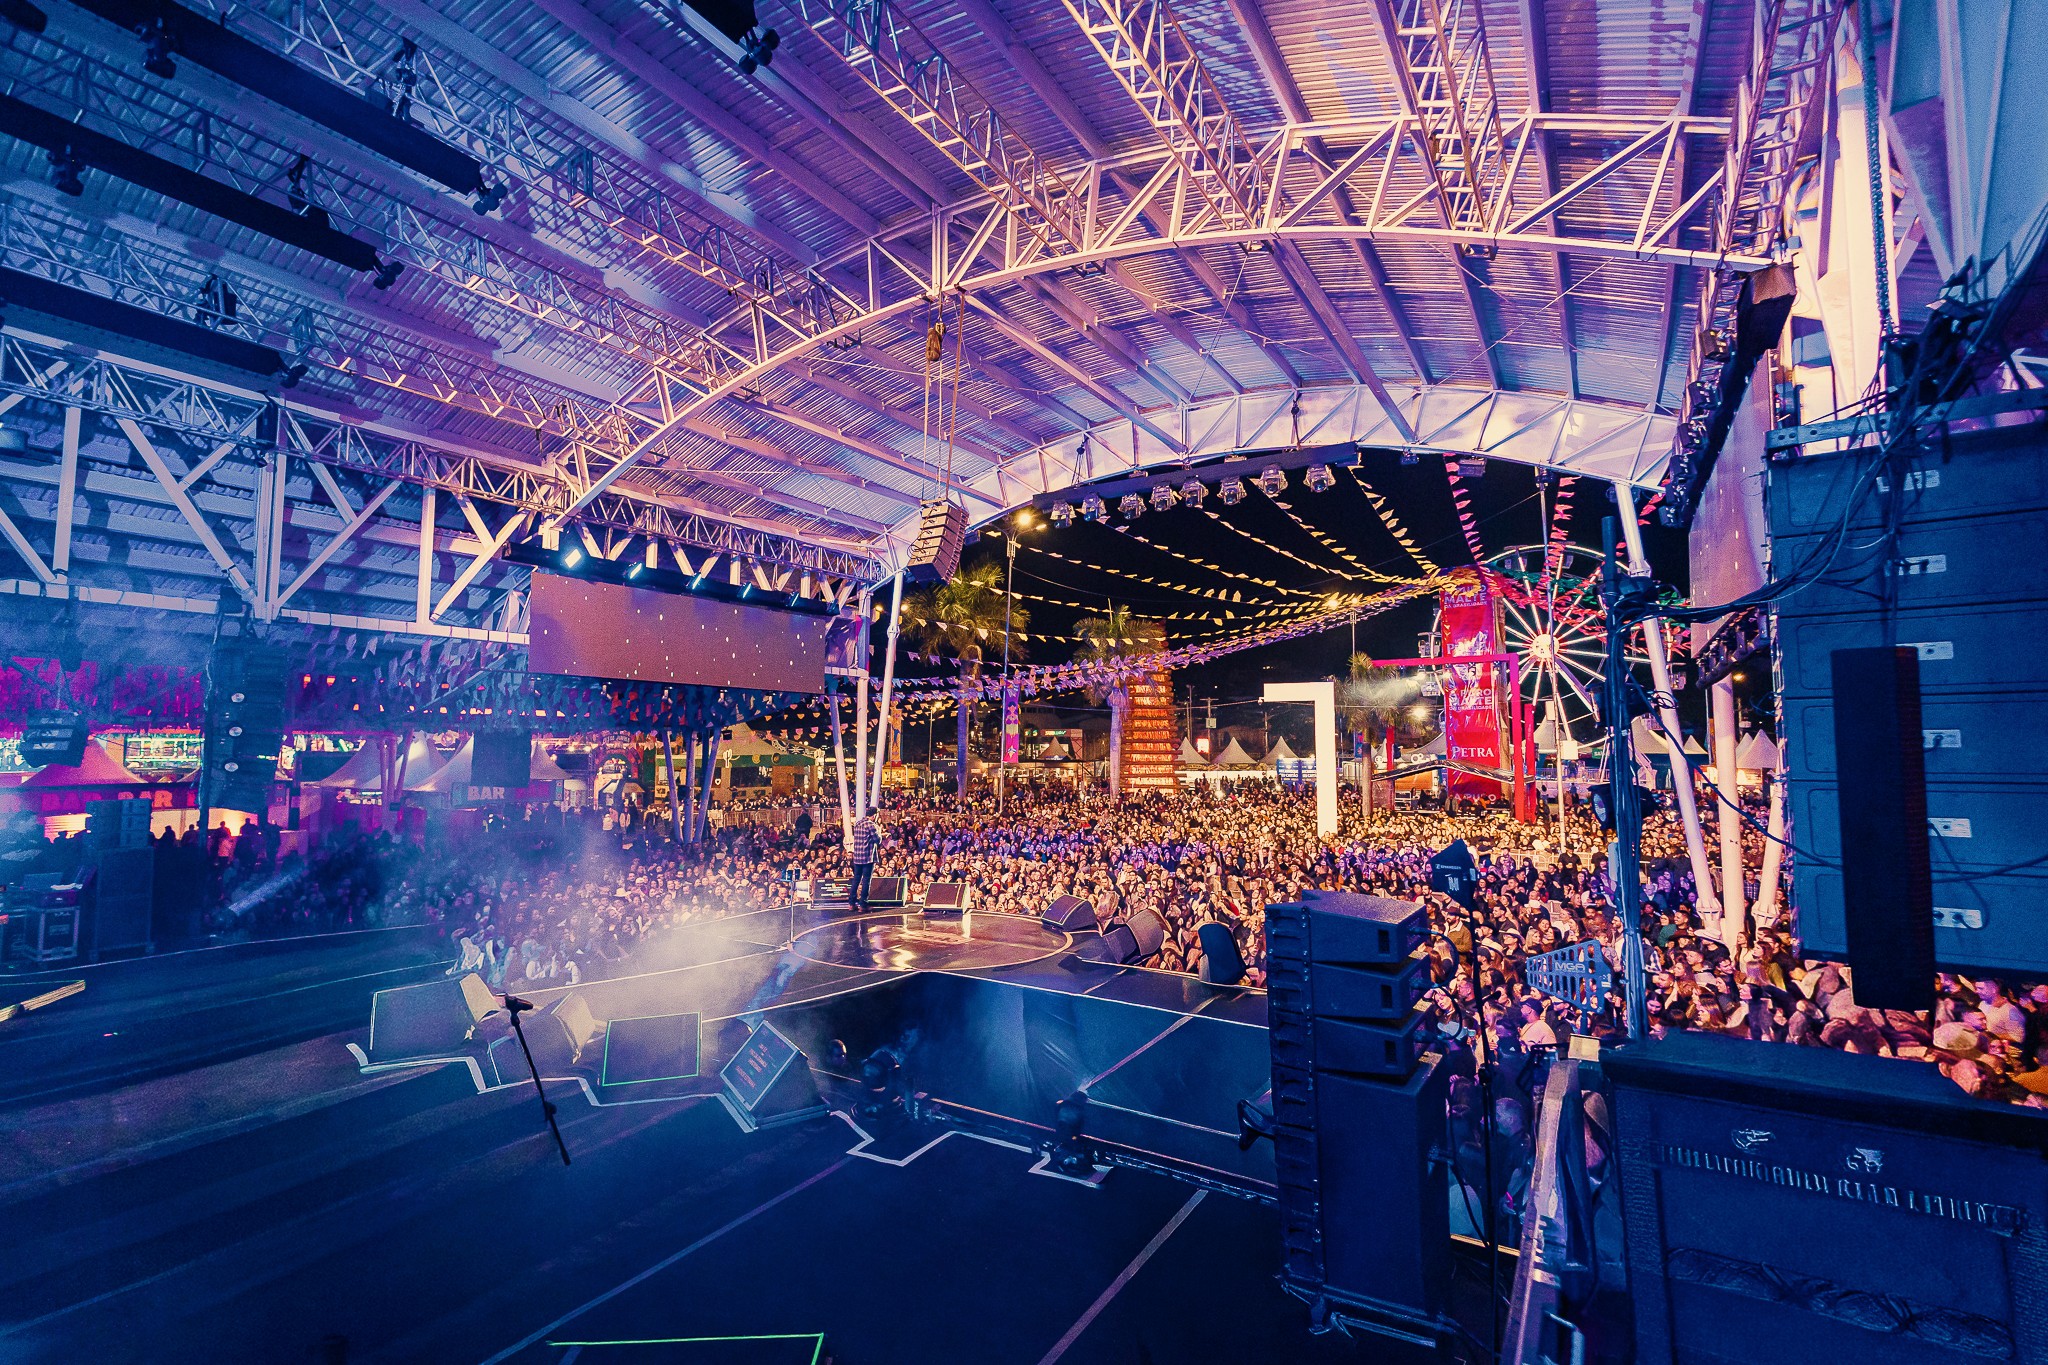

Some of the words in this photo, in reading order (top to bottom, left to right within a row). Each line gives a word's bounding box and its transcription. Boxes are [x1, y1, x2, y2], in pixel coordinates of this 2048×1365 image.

[1452, 746, 1494, 758] PETRA
[468, 785, 505, 800] BAR
[1467, 793, 1496, 801] PUO
[1555, 962, 1585, 973] MGA
